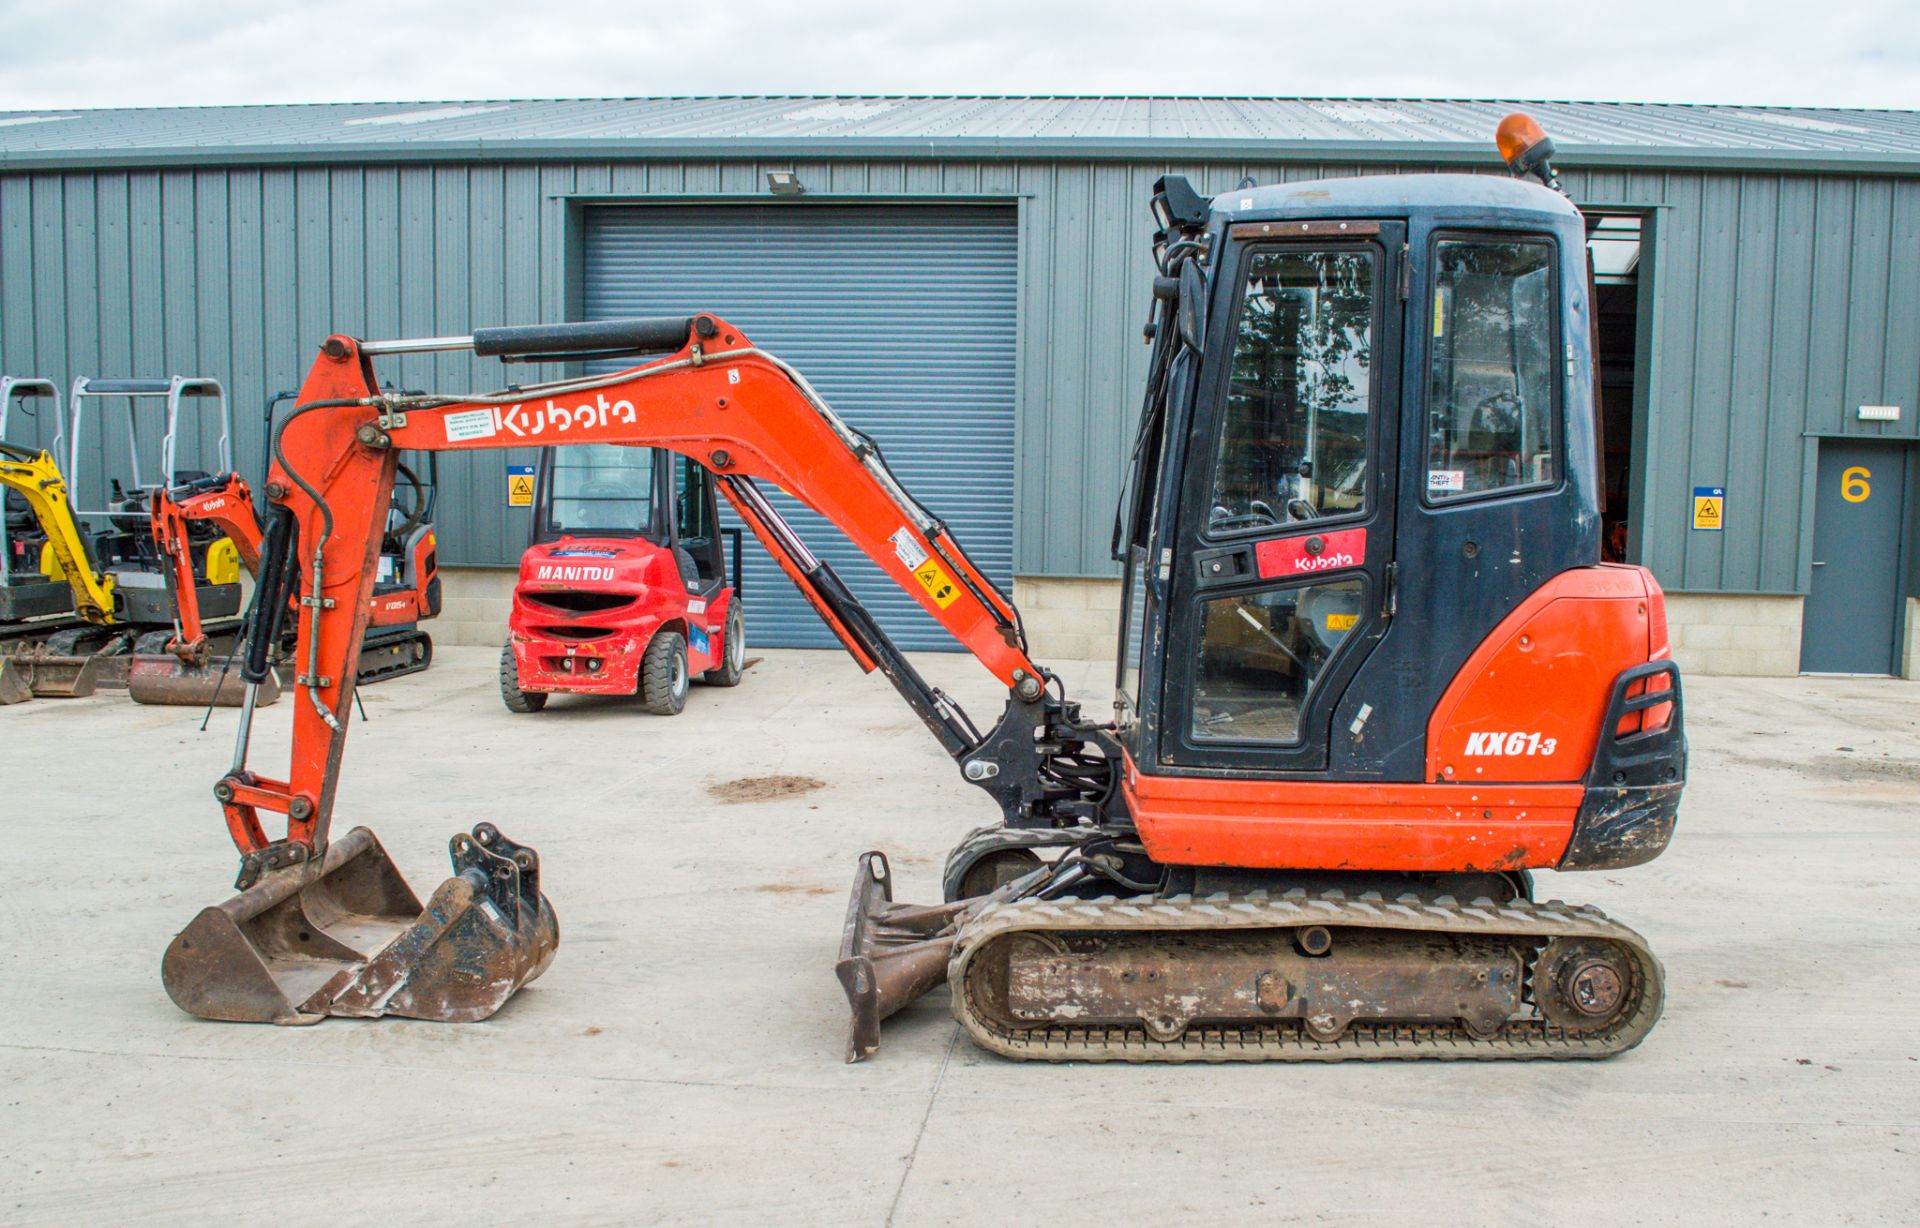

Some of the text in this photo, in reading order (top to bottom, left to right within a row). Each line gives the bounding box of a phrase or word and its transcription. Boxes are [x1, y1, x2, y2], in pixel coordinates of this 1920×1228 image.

[493, 393, 636, 436] Kubota
[1841, 465, 1871, 503] 6
[538, 566, 614, 581] MANITOU
[1295, 553, 1353, 571] Kubota
[1464, 731, 1557, 756] KX61-3
